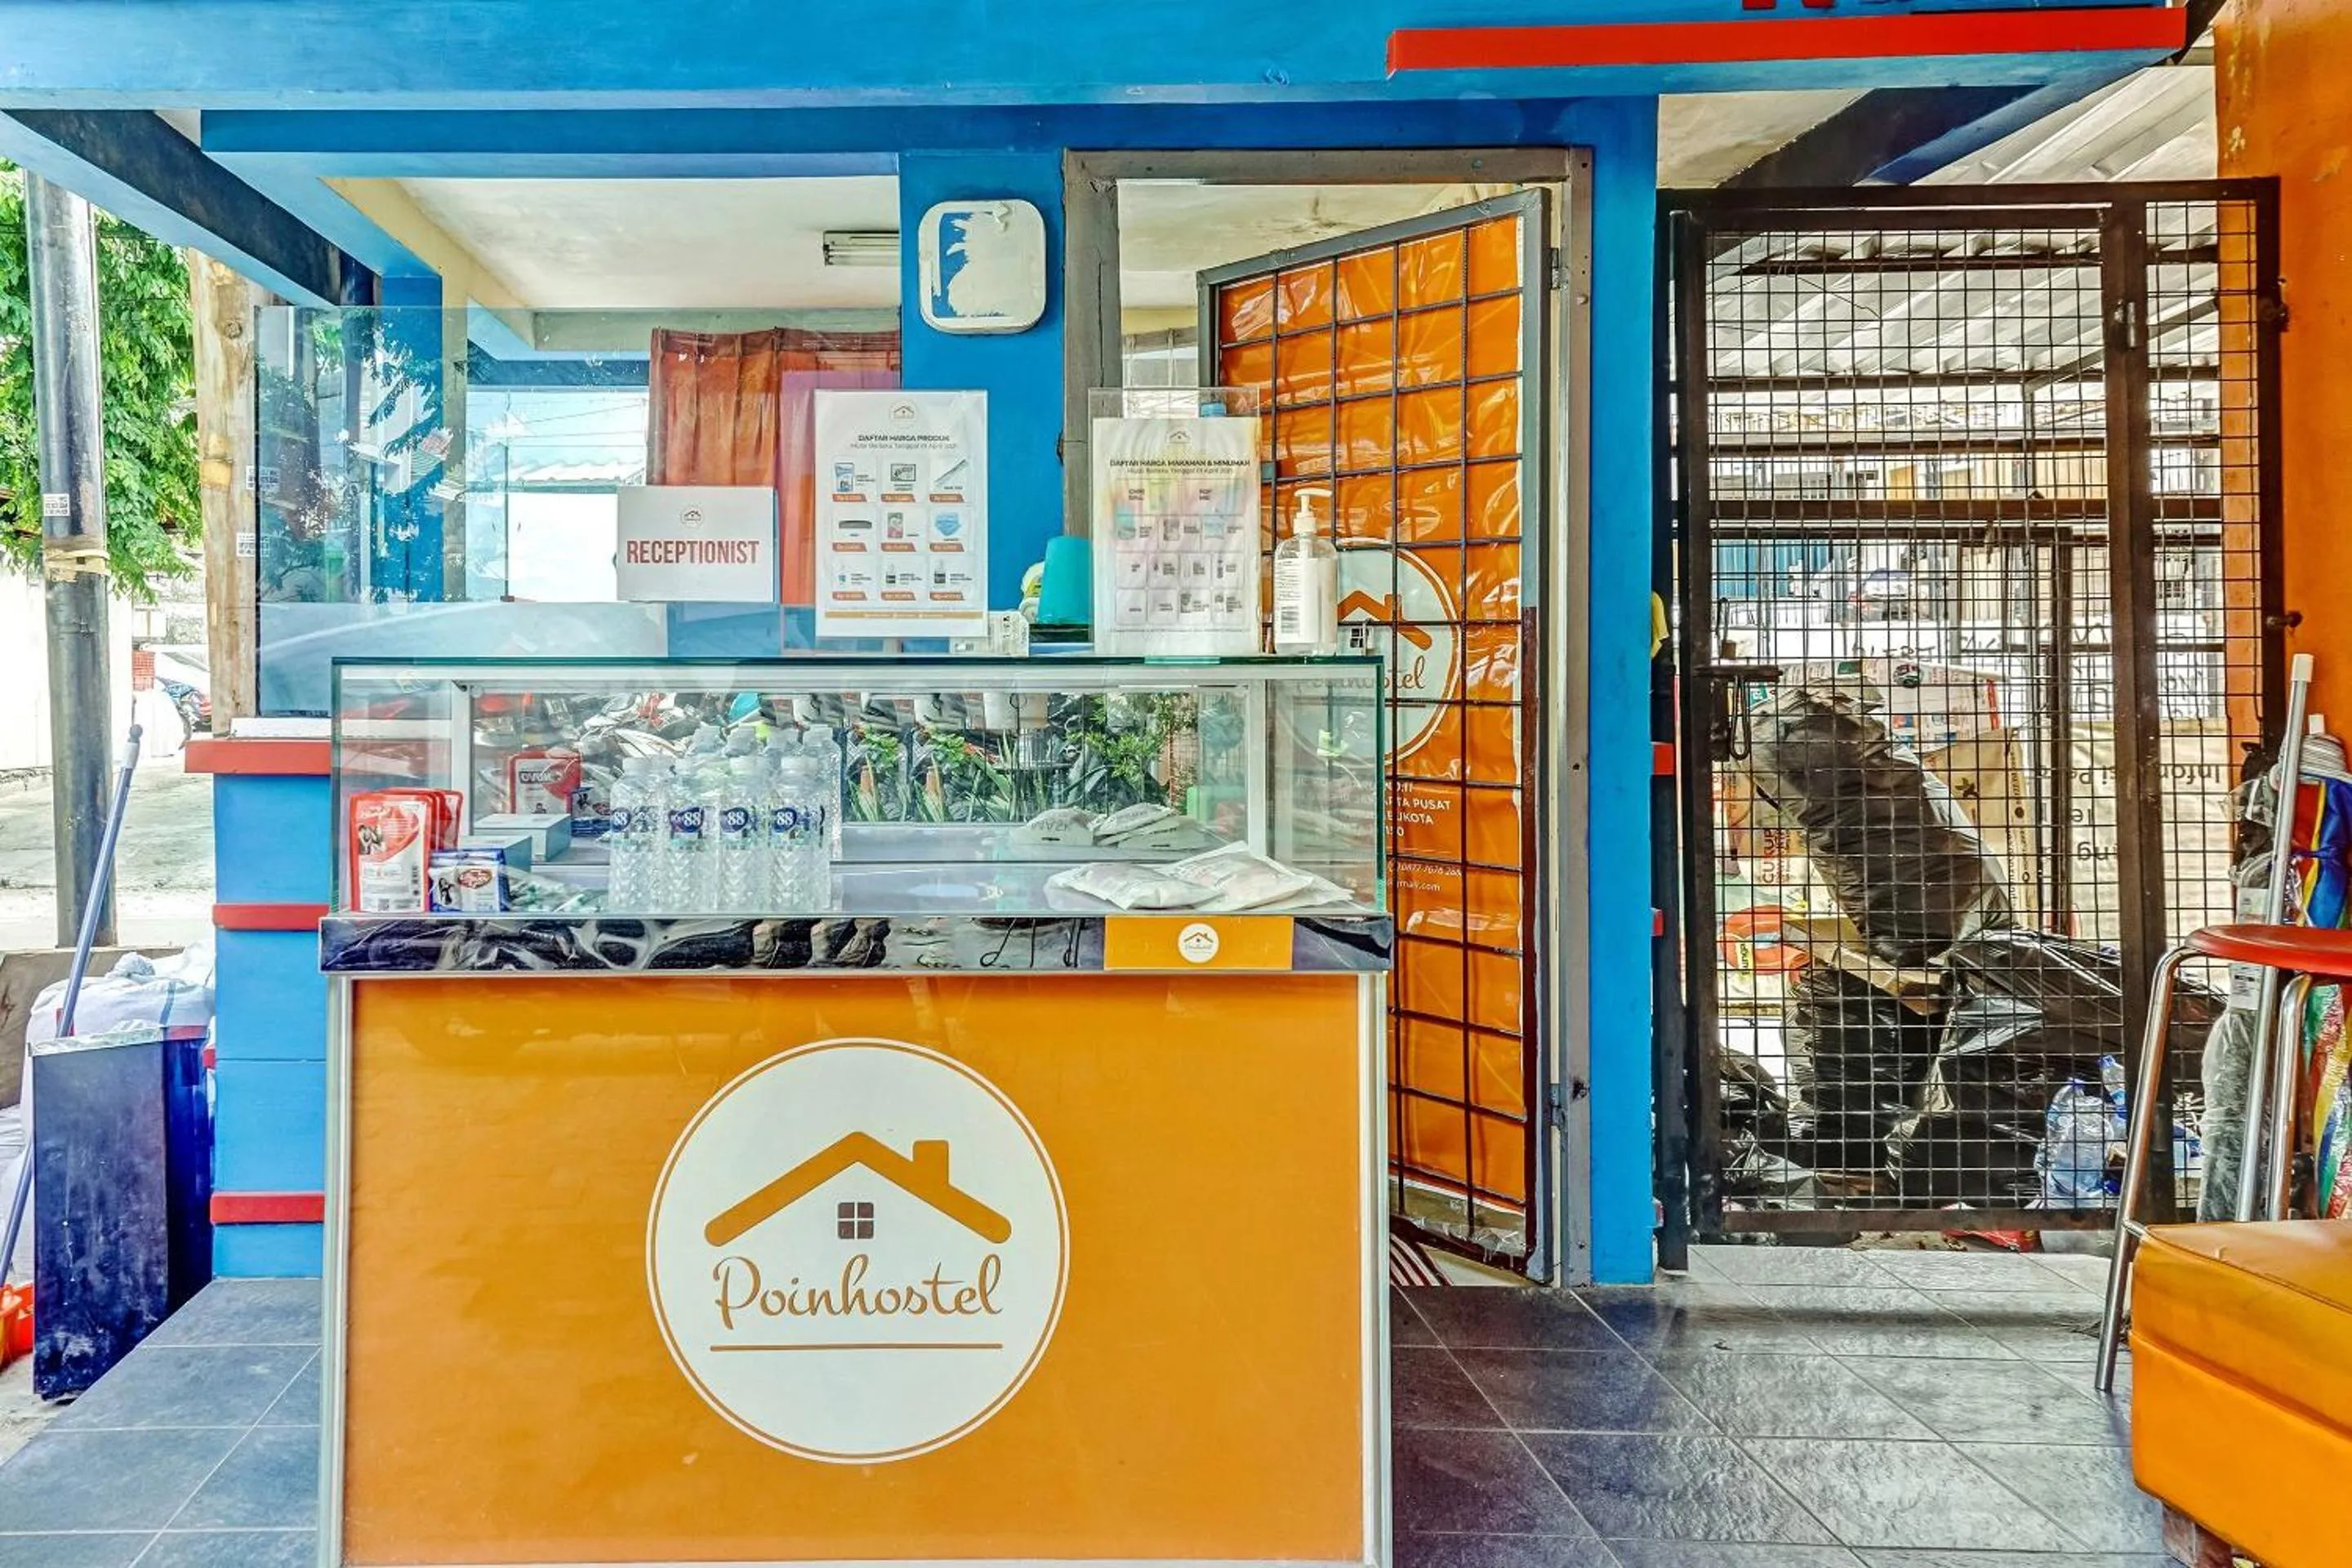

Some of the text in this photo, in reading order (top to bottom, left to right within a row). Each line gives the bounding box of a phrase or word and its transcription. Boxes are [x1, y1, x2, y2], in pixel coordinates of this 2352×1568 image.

[626, 540, 760, 564] RECEPTIONIST
[1412, 797, 1452, 812] PUSAT
[712, 1254, 1004, 1330] Poinhostel
